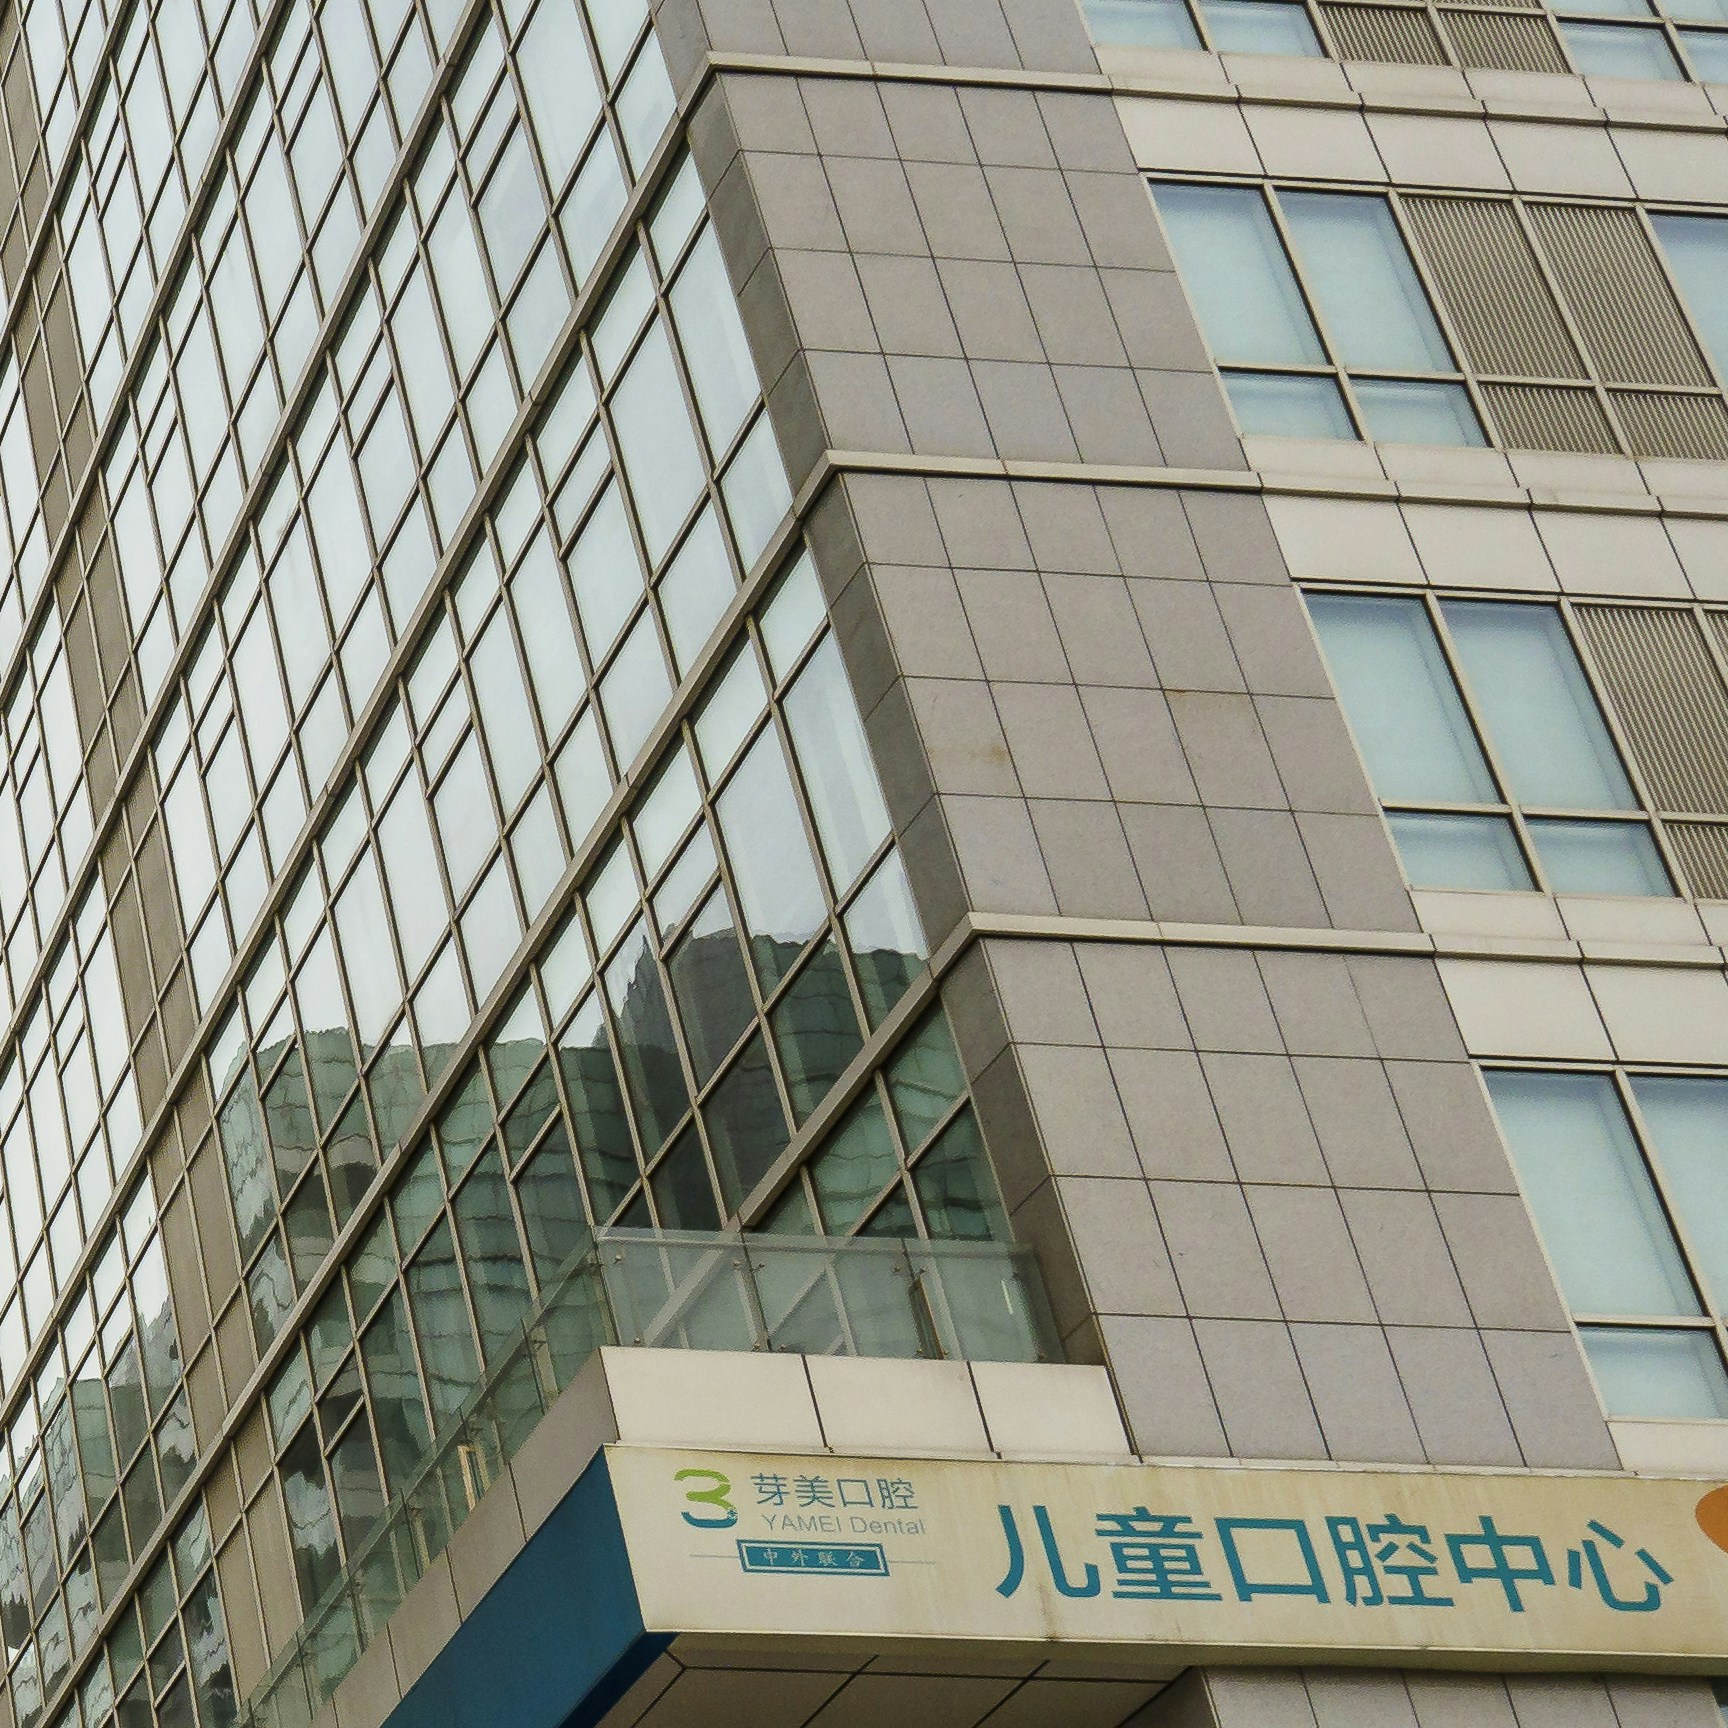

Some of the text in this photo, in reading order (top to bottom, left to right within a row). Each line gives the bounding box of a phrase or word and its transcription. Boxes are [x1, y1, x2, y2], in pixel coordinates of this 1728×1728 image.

[749, 1472, 919, 1510] 芽美口腔
[761, 1514, 927, 1536] YAMEI Dental
[995, 1504, 1675, 1613] 儿童口腔中心
